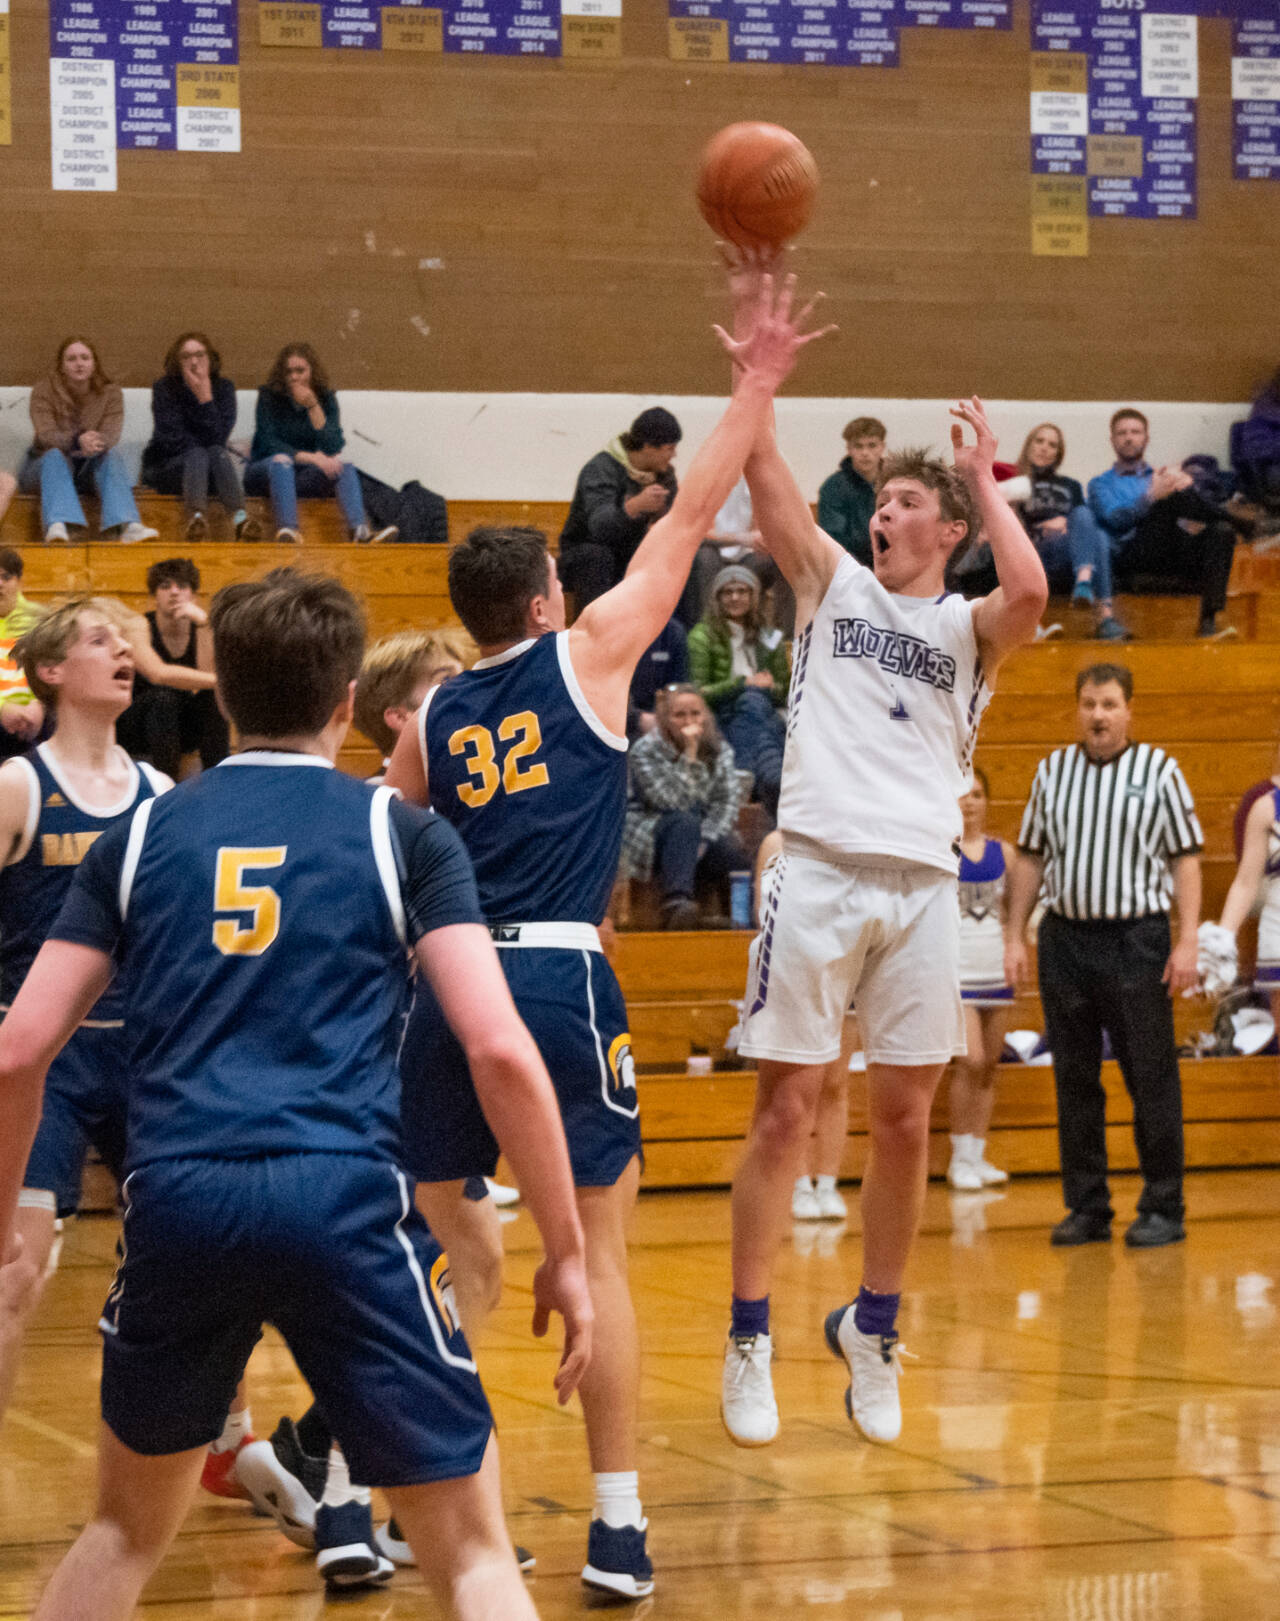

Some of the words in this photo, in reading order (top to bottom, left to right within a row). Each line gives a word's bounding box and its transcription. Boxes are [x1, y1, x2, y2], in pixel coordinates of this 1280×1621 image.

[905, 1, 951, 12] CHAMPION
[962, 2, 1008, 14] CHAMPION
[1100, 0, 1146, 10] BOYS
[264, 10, 282, 20] 1ST
[286, 10, 316, 22] STATE
[334, 7, 369, 18] LEAGUE
[455, 12, 490, 24] LEAGUE
[1042, 12, 1075, 24] LEAGUE
[63, 18, 100, 29] LEAGUE
[126, 20, 162, 32] LEAGUE
[327, 20, 376, 32] CHAMPION
[408, 15, 438, 26] STATE
[514, 15, 550, 27] LEAGUE
[1098, 15, 1130, 26] LEAGUE
[1152, 18, 1187, 26] DISTRICT
[1243, 20, 1275, 31] LEAGUE
[189, 22, 225, 34] LEAGUE
[448, 25, 496, 37] CHAMPION
[739, 22, 774, 33] LEAGUE
[796, 24, 832, 36] LEAGUE
[1036, 26, 1082, 38] CHAMPION
[57, 32, 107, 43] CHAMPION
[506, 28, 558, 40] CHAMPION
[853, 28, 888, 39] LEAGUE
[1092, 28, 1136, 39] CHAMPION
[1148, 32, 1190, 40] CHAMPION
[120, 34, 170, 46] CHAMPION
[182, 36, 232, 48] CHAMPION
[734, 34, 780, 47] CHAMPION
[791, 37, 838, 49] CHAMPION
[847, 40, 895, 52] CHAMPION
[1098, 55, 1131, 66] LEAGUE
[1152, 59, 1188, 67] DISTRICT
[62, 62, 104, 72] DISTRICT
[127, 64, 163, 75] LEAGUE
[204, 72, 236, 83] STATE
[1092, 68, 1138, 80] CHAMPION
[1148, 73, 1191, 82] CHAMPION
[58, 76, 107, 87] CHAMPION
[120, 77, 170, 89] CHAMPION
[1041, 96, 1077, 105] DISTRICT
[1098, 96, 1132, 108] LEAGUE
[1153, 99, 1187, 110] LEAGUE
[62, 105, 104, 116] DISTRICT
[128, 107, 164, 118] LEAGUE
[1038, 108, 1081, 118] CHAMPION
[1242, 102, 1277, 114] LEAGUE
[188, 110, 228, 120] DISTRICT
[1092, 109, 1138, 121] CHAMPION
[1146, 112, 1194, 123] CHAMPION
[58, 119, 108, 130] CHAMPION
[121, 121, 171, 133] CHAMPION
[184, 124, 232, 134] CHAMPION
[1042, 136, 1077, 148] LEAGUE
[1153, 138, 1186, 150] LEAGUE
[64, 149, 104, 159] DISTRICT
[1036, 148, 1082, 160] CHAMPION
[1242, 143, 1276, 154] LEAGUE
[1146, 152, 1193, 163] CHAMPION
[60, 163, 109, 174] CHAMPION
[1097, 178, 1132, 190] LEAGUE
[1153, 180, 1185, 191] LEAGUE
[1091, 190, 1138, 202] CHAMPION
[1147, 192, 1192, 204] CHAMPION
[833, 618, 956, 693] WOLVES
[448, 710, 550, 808] 32
[212, 845, 288, 956] 5
